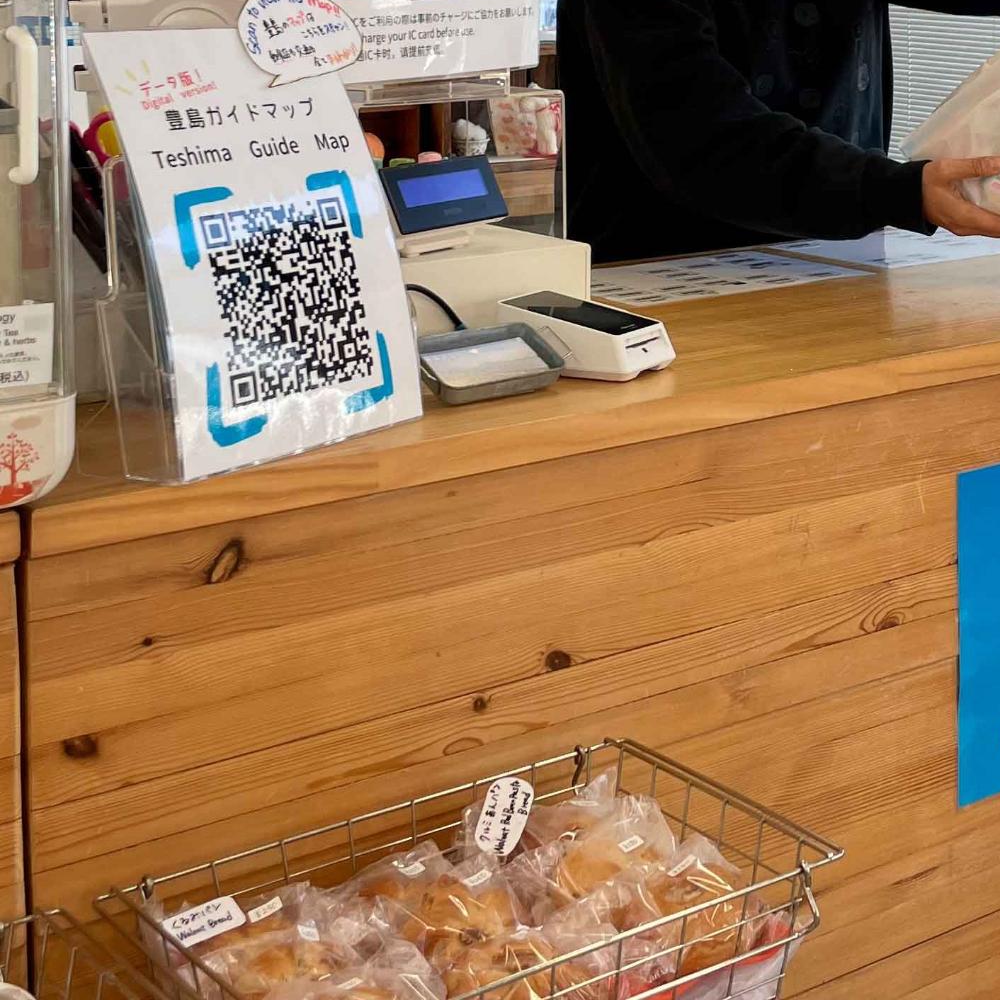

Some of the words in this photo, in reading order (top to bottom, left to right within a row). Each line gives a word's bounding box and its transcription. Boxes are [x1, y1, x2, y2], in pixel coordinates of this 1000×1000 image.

[246, 6, 260, 19] to
[361, 32, 386, 45] harge
[388, 32, 407, 45] your
[408, 30, 417, 40] IC
[418, 27, 435, 39] card
[436, 26, 460, 39] before
[140, 94, 175, 111] Digital
[165, 97, 314, 131] 豊島ガイドマップ
[152, 146, 233, 169] Teshima
[250, 136, 300, 158] Guide
[314, 133, 350, 153] Map
[517, 791, 531, 816] Bread
[176, 924, 206, 941] Walnut
[208, 911, 233, 928] Bread
